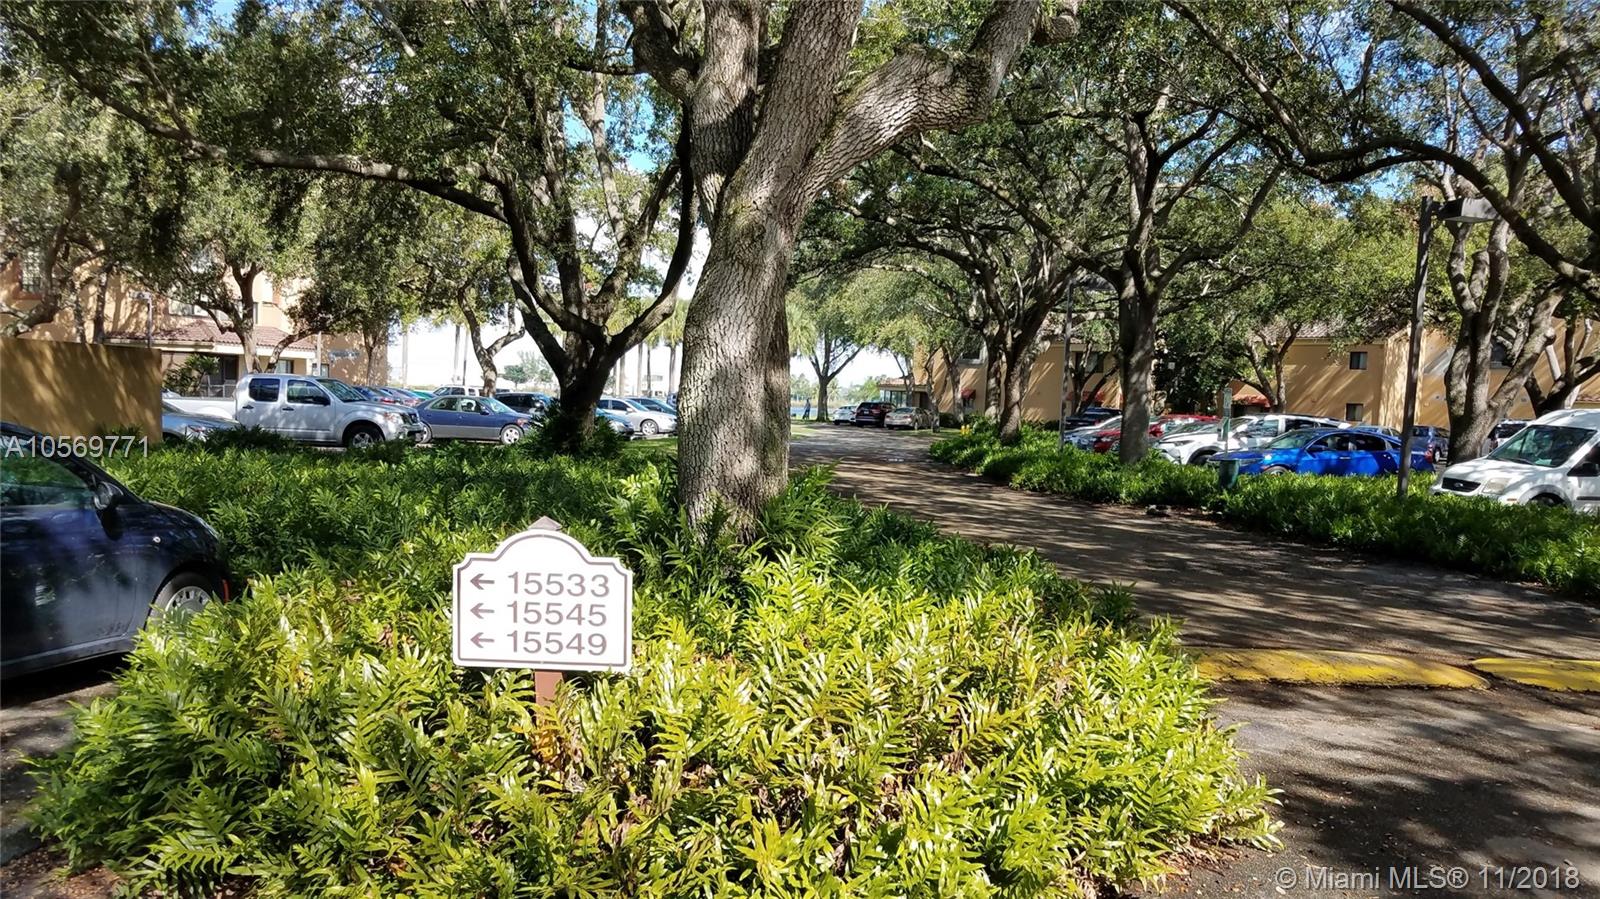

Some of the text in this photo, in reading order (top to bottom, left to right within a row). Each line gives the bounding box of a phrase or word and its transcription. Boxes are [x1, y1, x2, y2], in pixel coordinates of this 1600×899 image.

[507, 571, 610, 598] 15533
[506, 600, 608, 627] 15545
[506, 630, 608, 656] 15549
